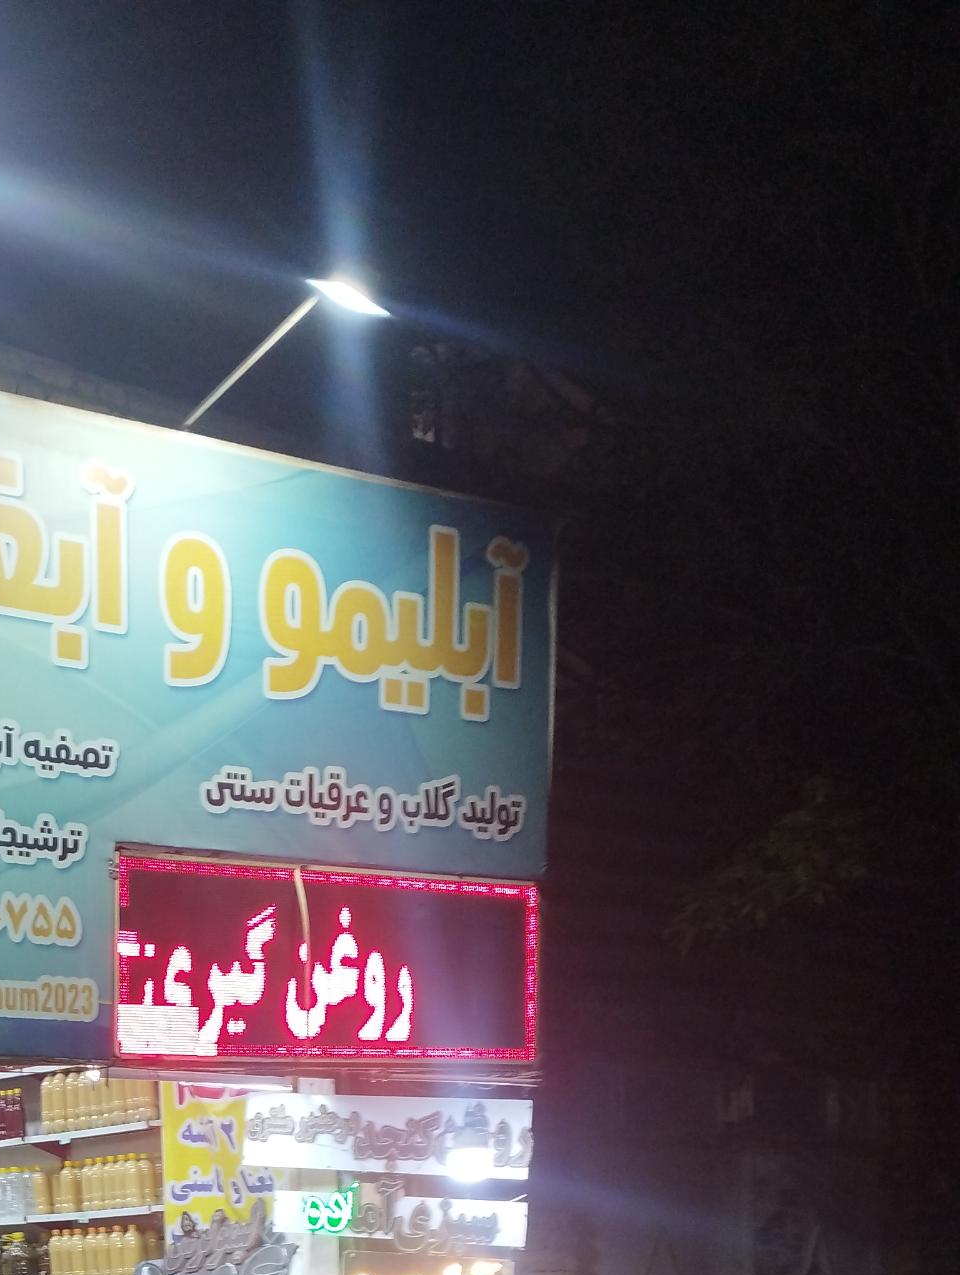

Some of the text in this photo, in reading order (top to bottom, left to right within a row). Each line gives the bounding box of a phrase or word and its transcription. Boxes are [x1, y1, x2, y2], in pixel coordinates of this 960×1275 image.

[161, 535, 228, 682] و
[263, 529, 528, 718] آبلیمو
[23, 735, 114, 771] تصفیه
[285, 772, 368, 821] عرقیات
[379, 792, 393, 825] و
[401, 780, 455, 826] گلاب
[462, 791, 523, 836] تولید
[285, 906, 413, 1041] روغن
